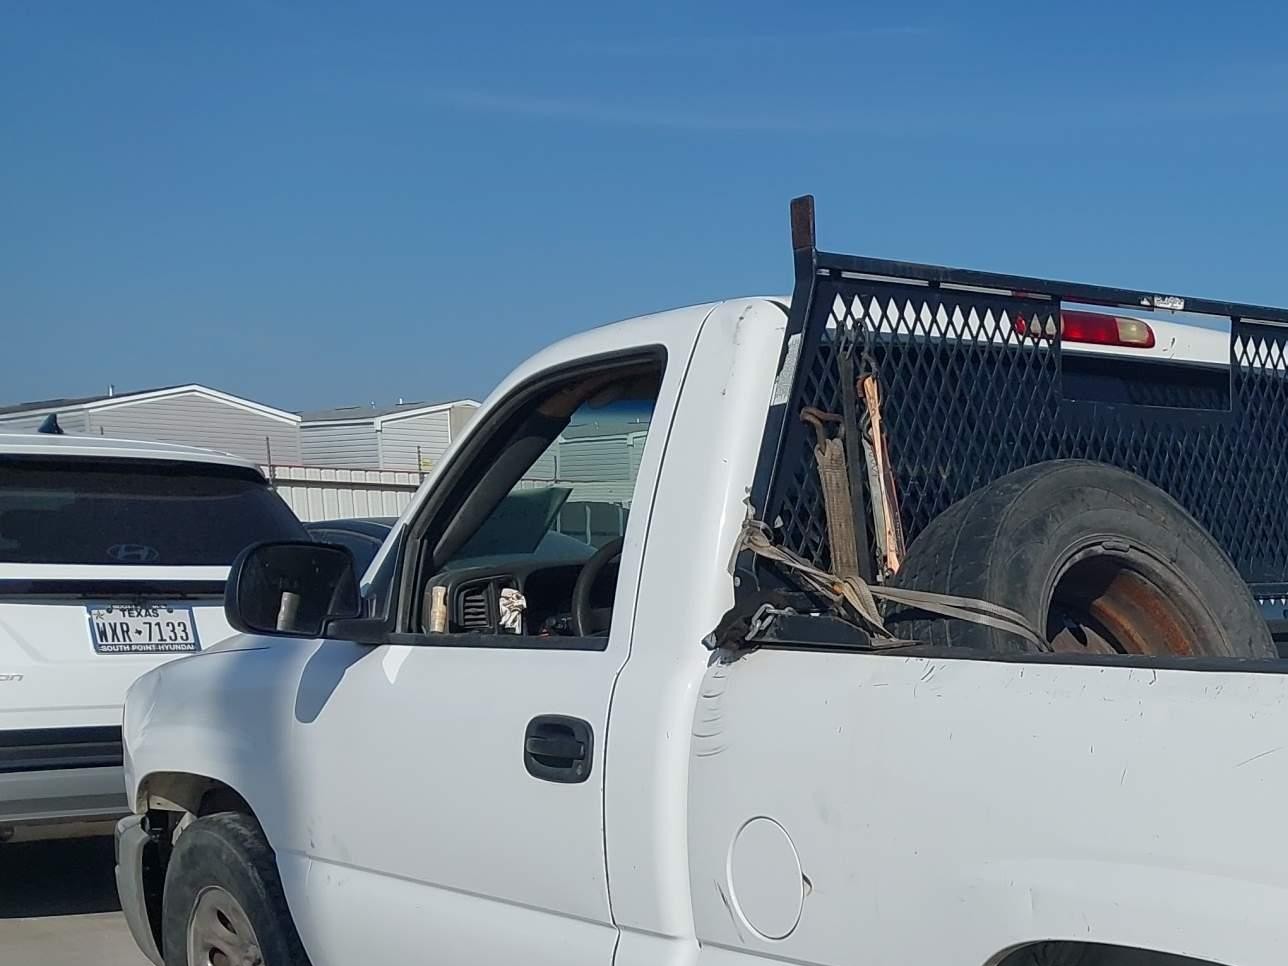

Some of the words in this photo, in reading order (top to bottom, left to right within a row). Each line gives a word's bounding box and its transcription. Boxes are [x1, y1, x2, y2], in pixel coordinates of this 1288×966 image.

[120, 608, 160, 618] TEXAS
[96, 621, 132, 642] WXR
[142, 621, 190, 642] 7133
[100, 644, 130, 652] SOUTH
